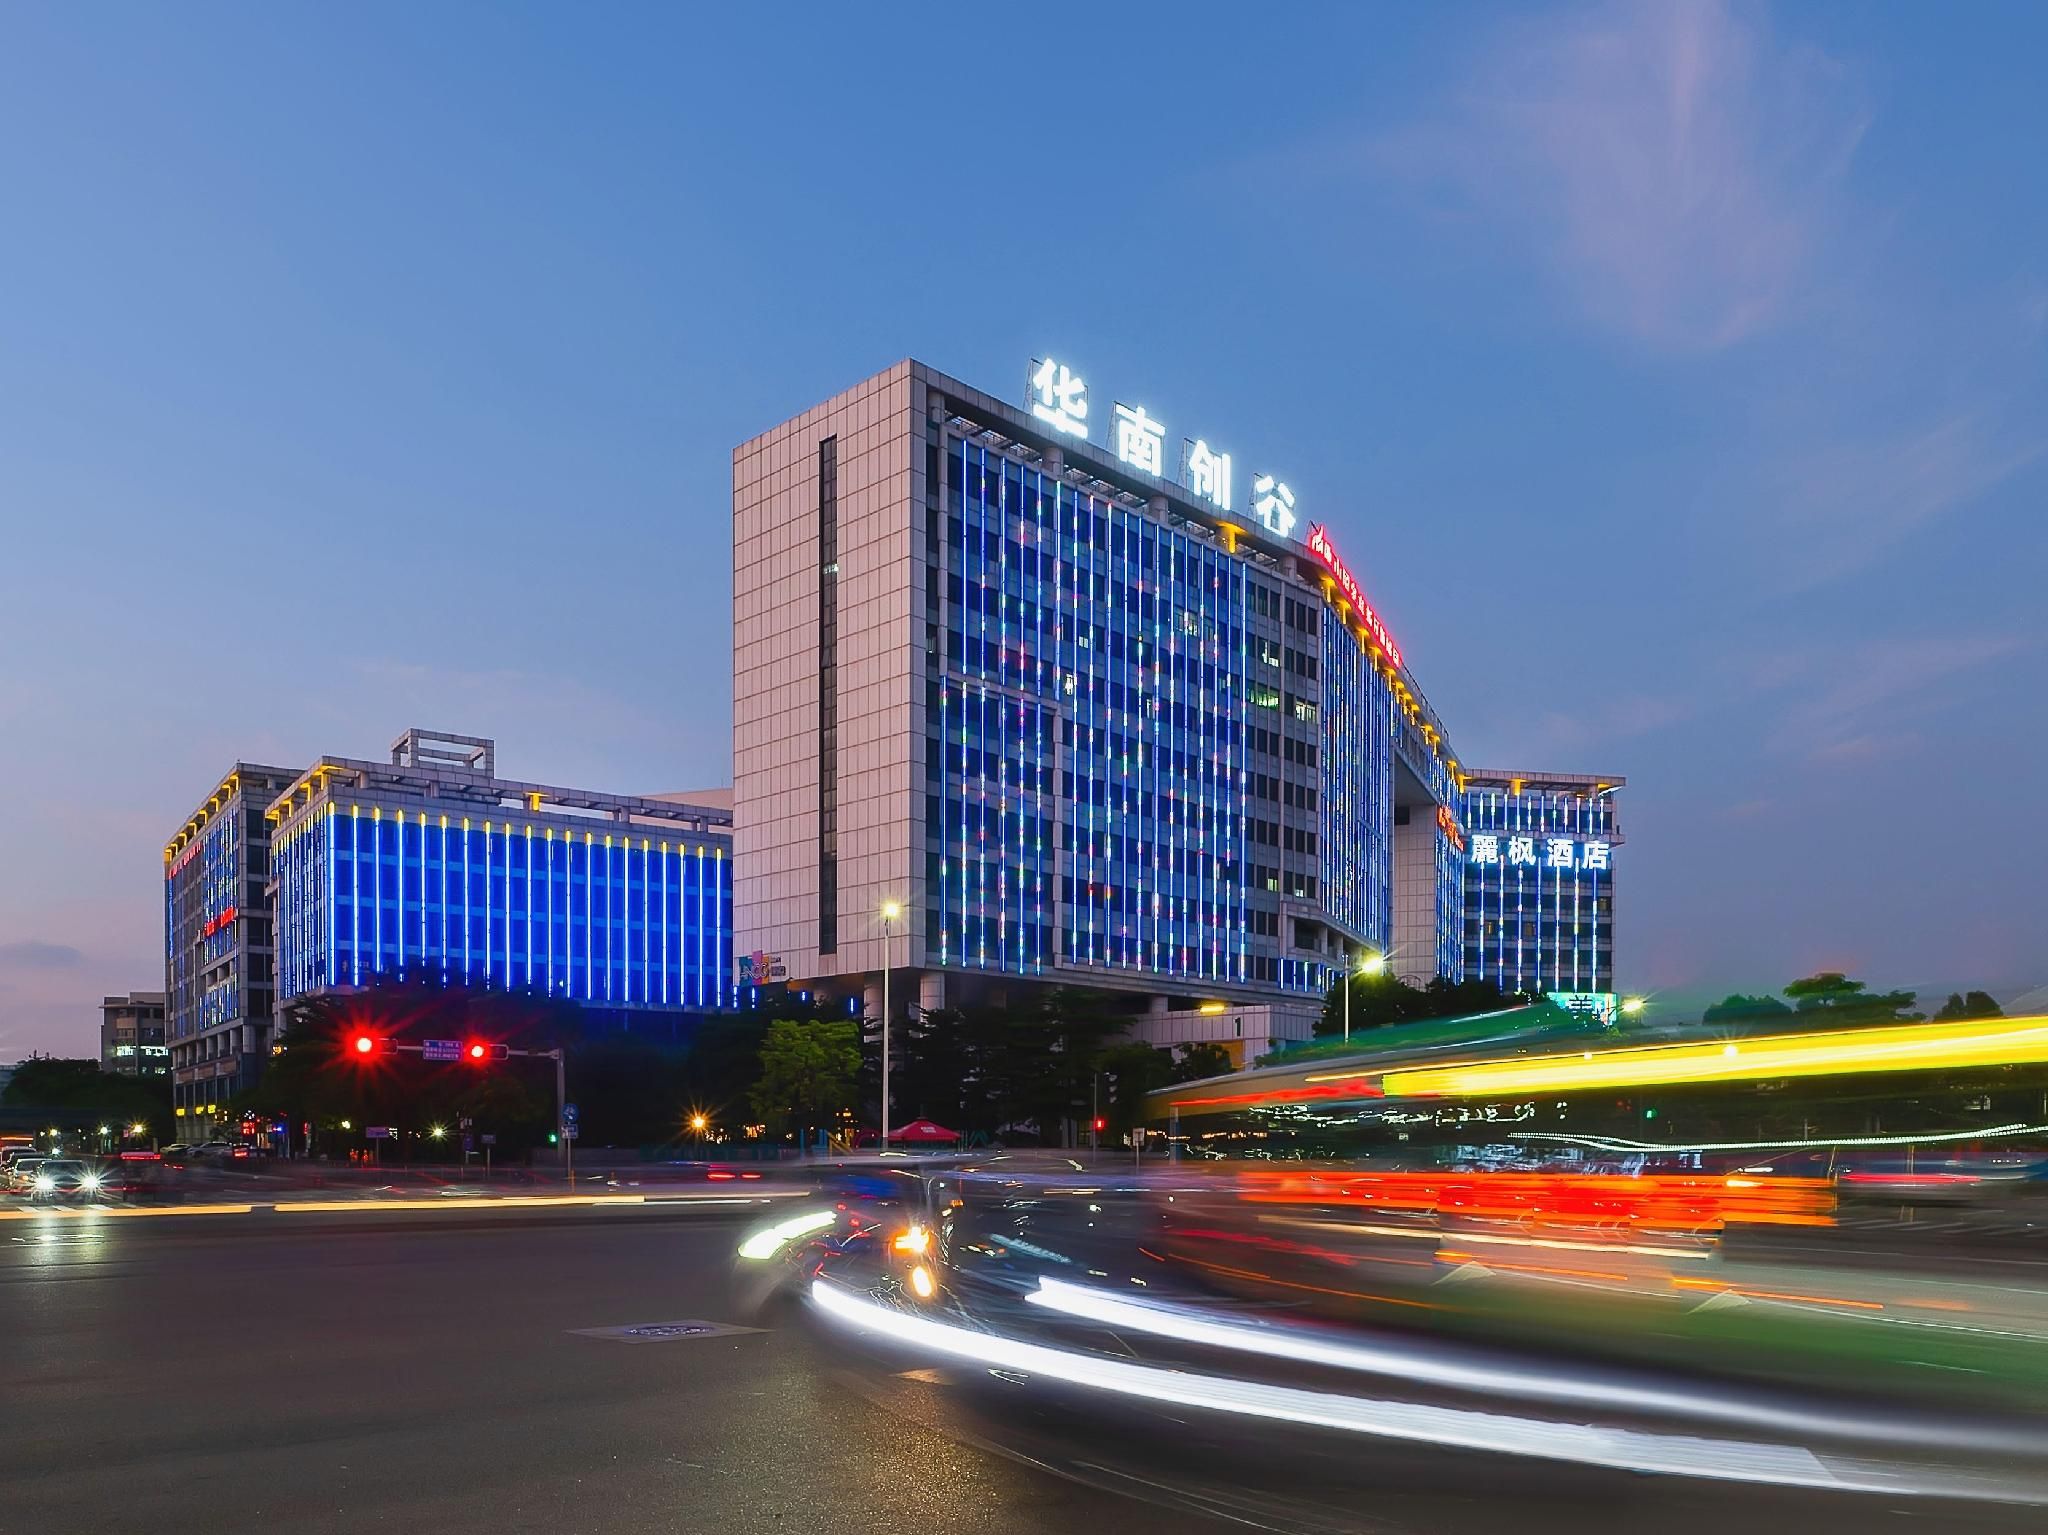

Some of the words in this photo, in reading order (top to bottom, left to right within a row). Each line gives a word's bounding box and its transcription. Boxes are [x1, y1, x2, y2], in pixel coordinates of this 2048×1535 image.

[1032, 357, 1297, 537] 华南创谷
[1471, 834, 1610, 870] 麗枫酒店
[1234, 1017, 1241, 1037] 1
